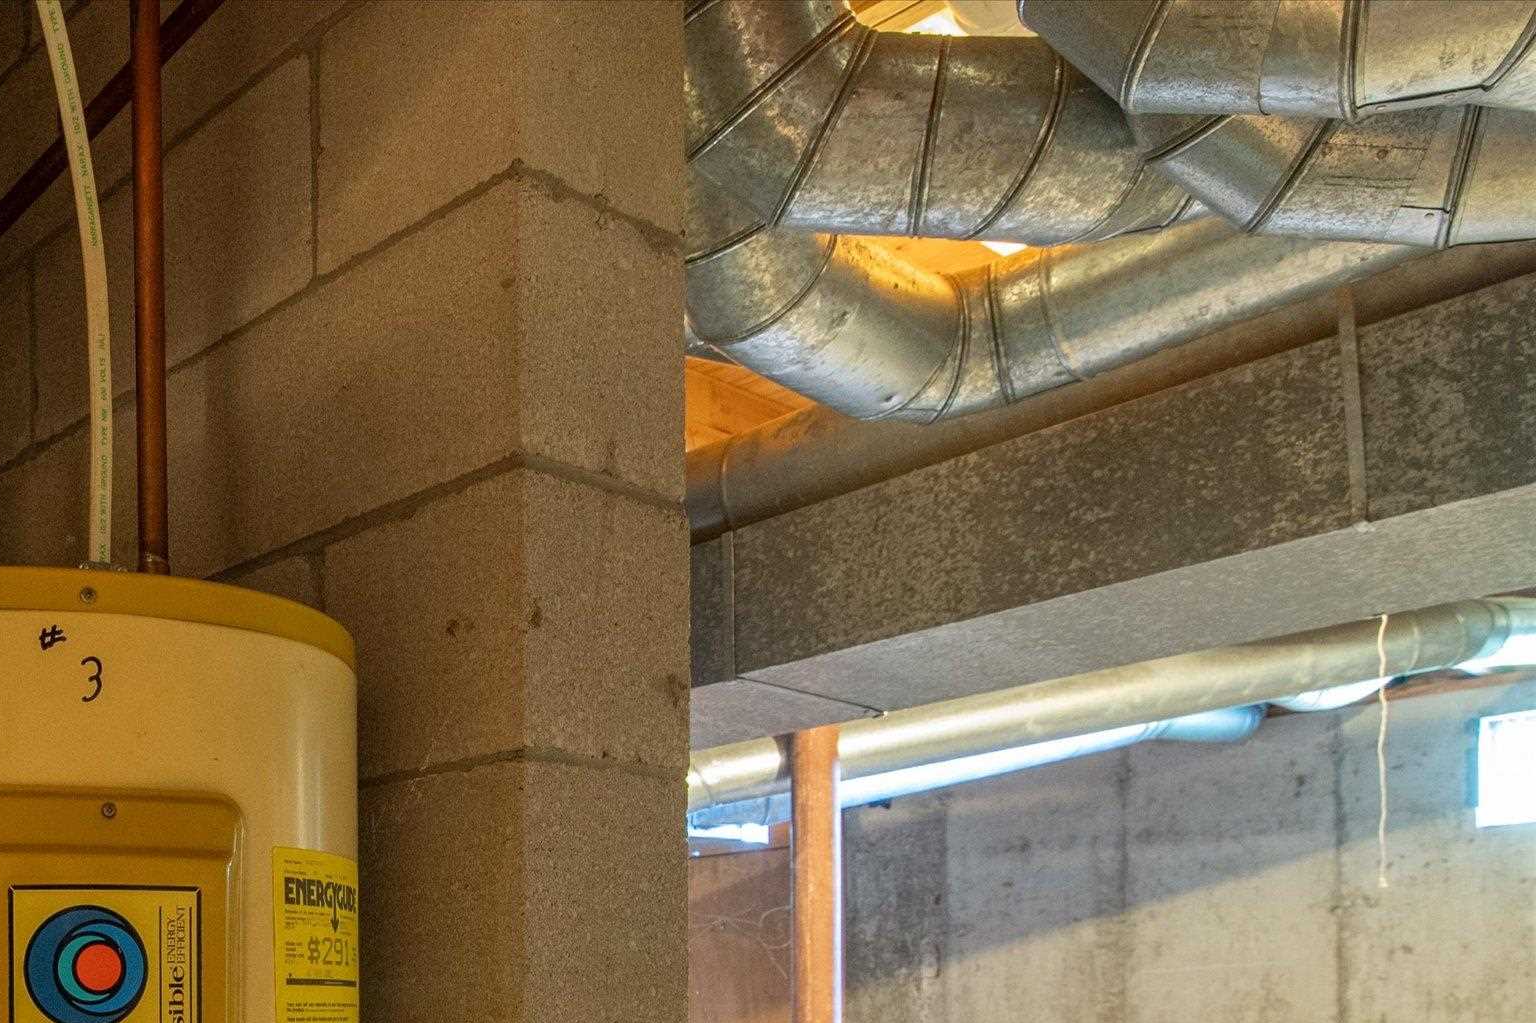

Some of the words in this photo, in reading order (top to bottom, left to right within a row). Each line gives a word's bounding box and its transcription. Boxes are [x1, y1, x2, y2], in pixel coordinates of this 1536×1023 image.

[81, 656, 102, 702] 3
[167, 918, 176, 964] ENERGY
[176, 906, 186, 964] EFFICIENT
